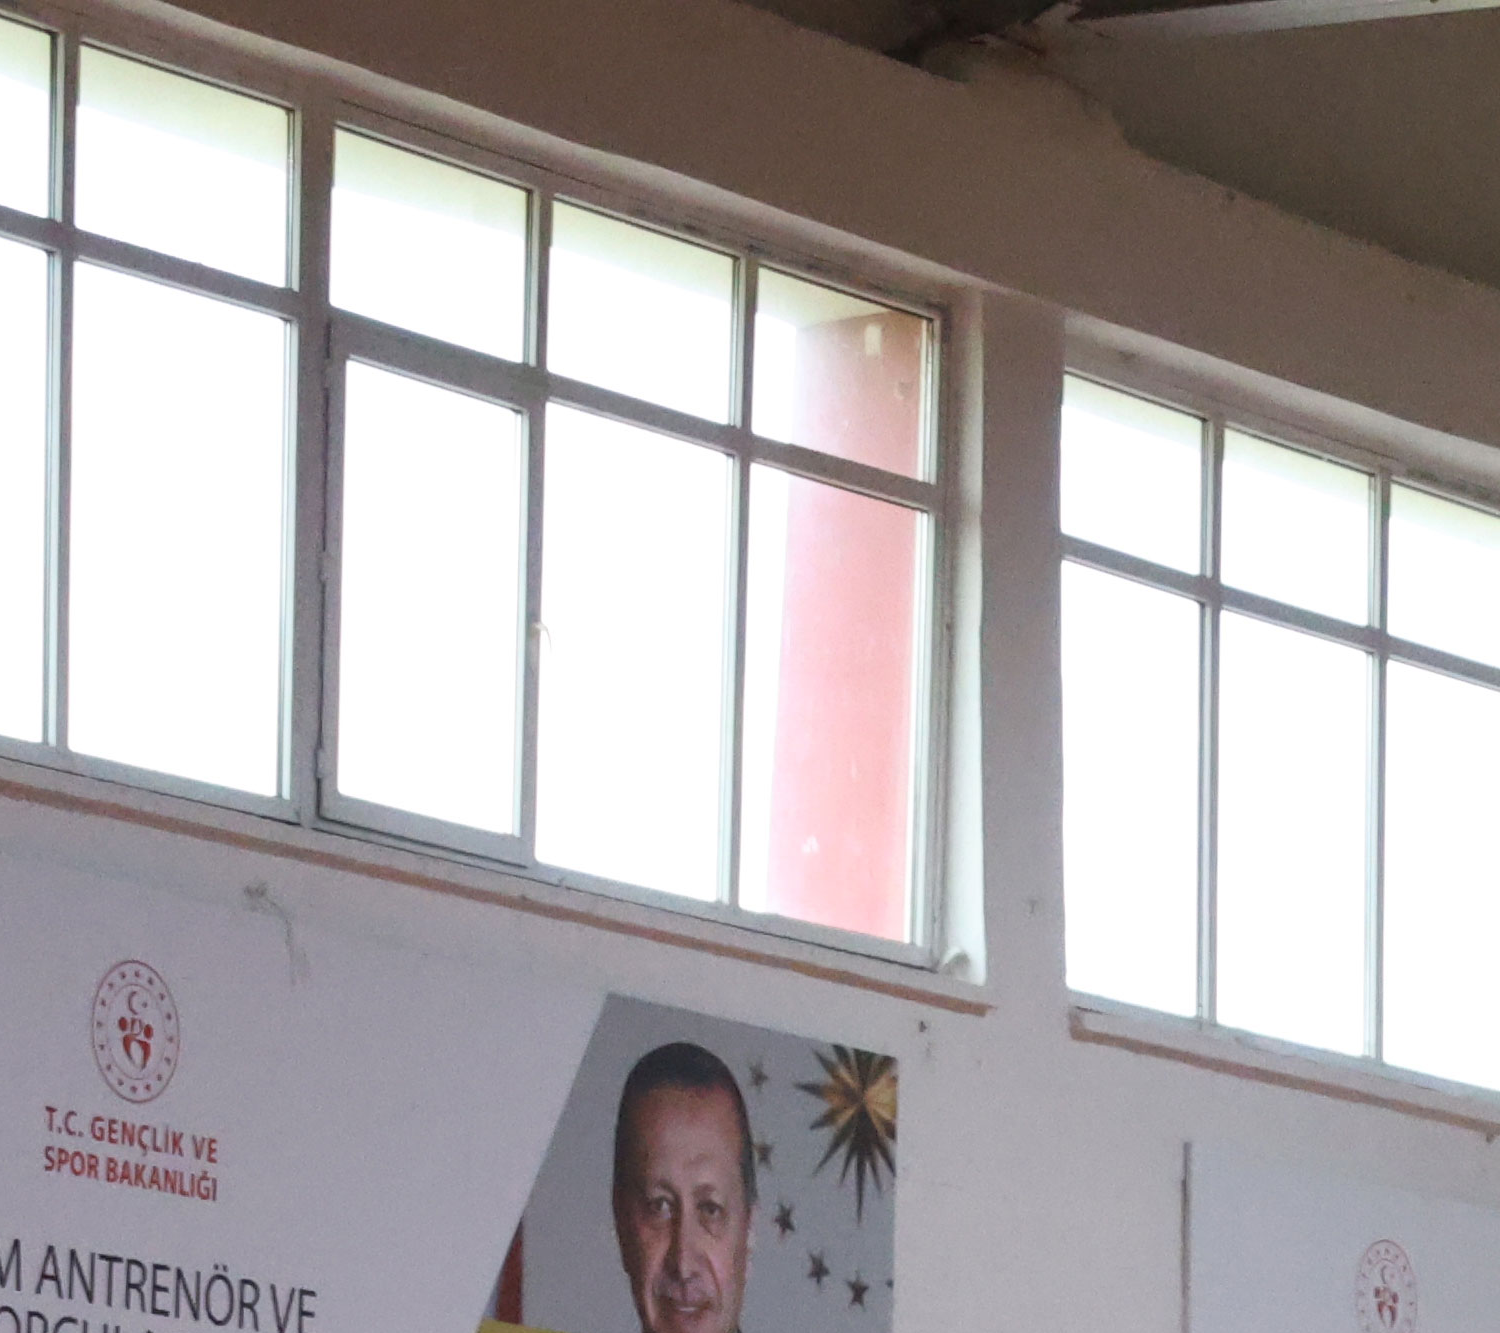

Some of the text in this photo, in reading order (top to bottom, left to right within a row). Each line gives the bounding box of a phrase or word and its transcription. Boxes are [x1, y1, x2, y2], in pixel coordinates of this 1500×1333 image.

[45, 1106, 217, 1164] T.C. GENÇLİK VE
[44, 1146, 217, 1201] SPOR BAKANLIĞI
[35, 1244, 259, 1333] ANTRENÖR
